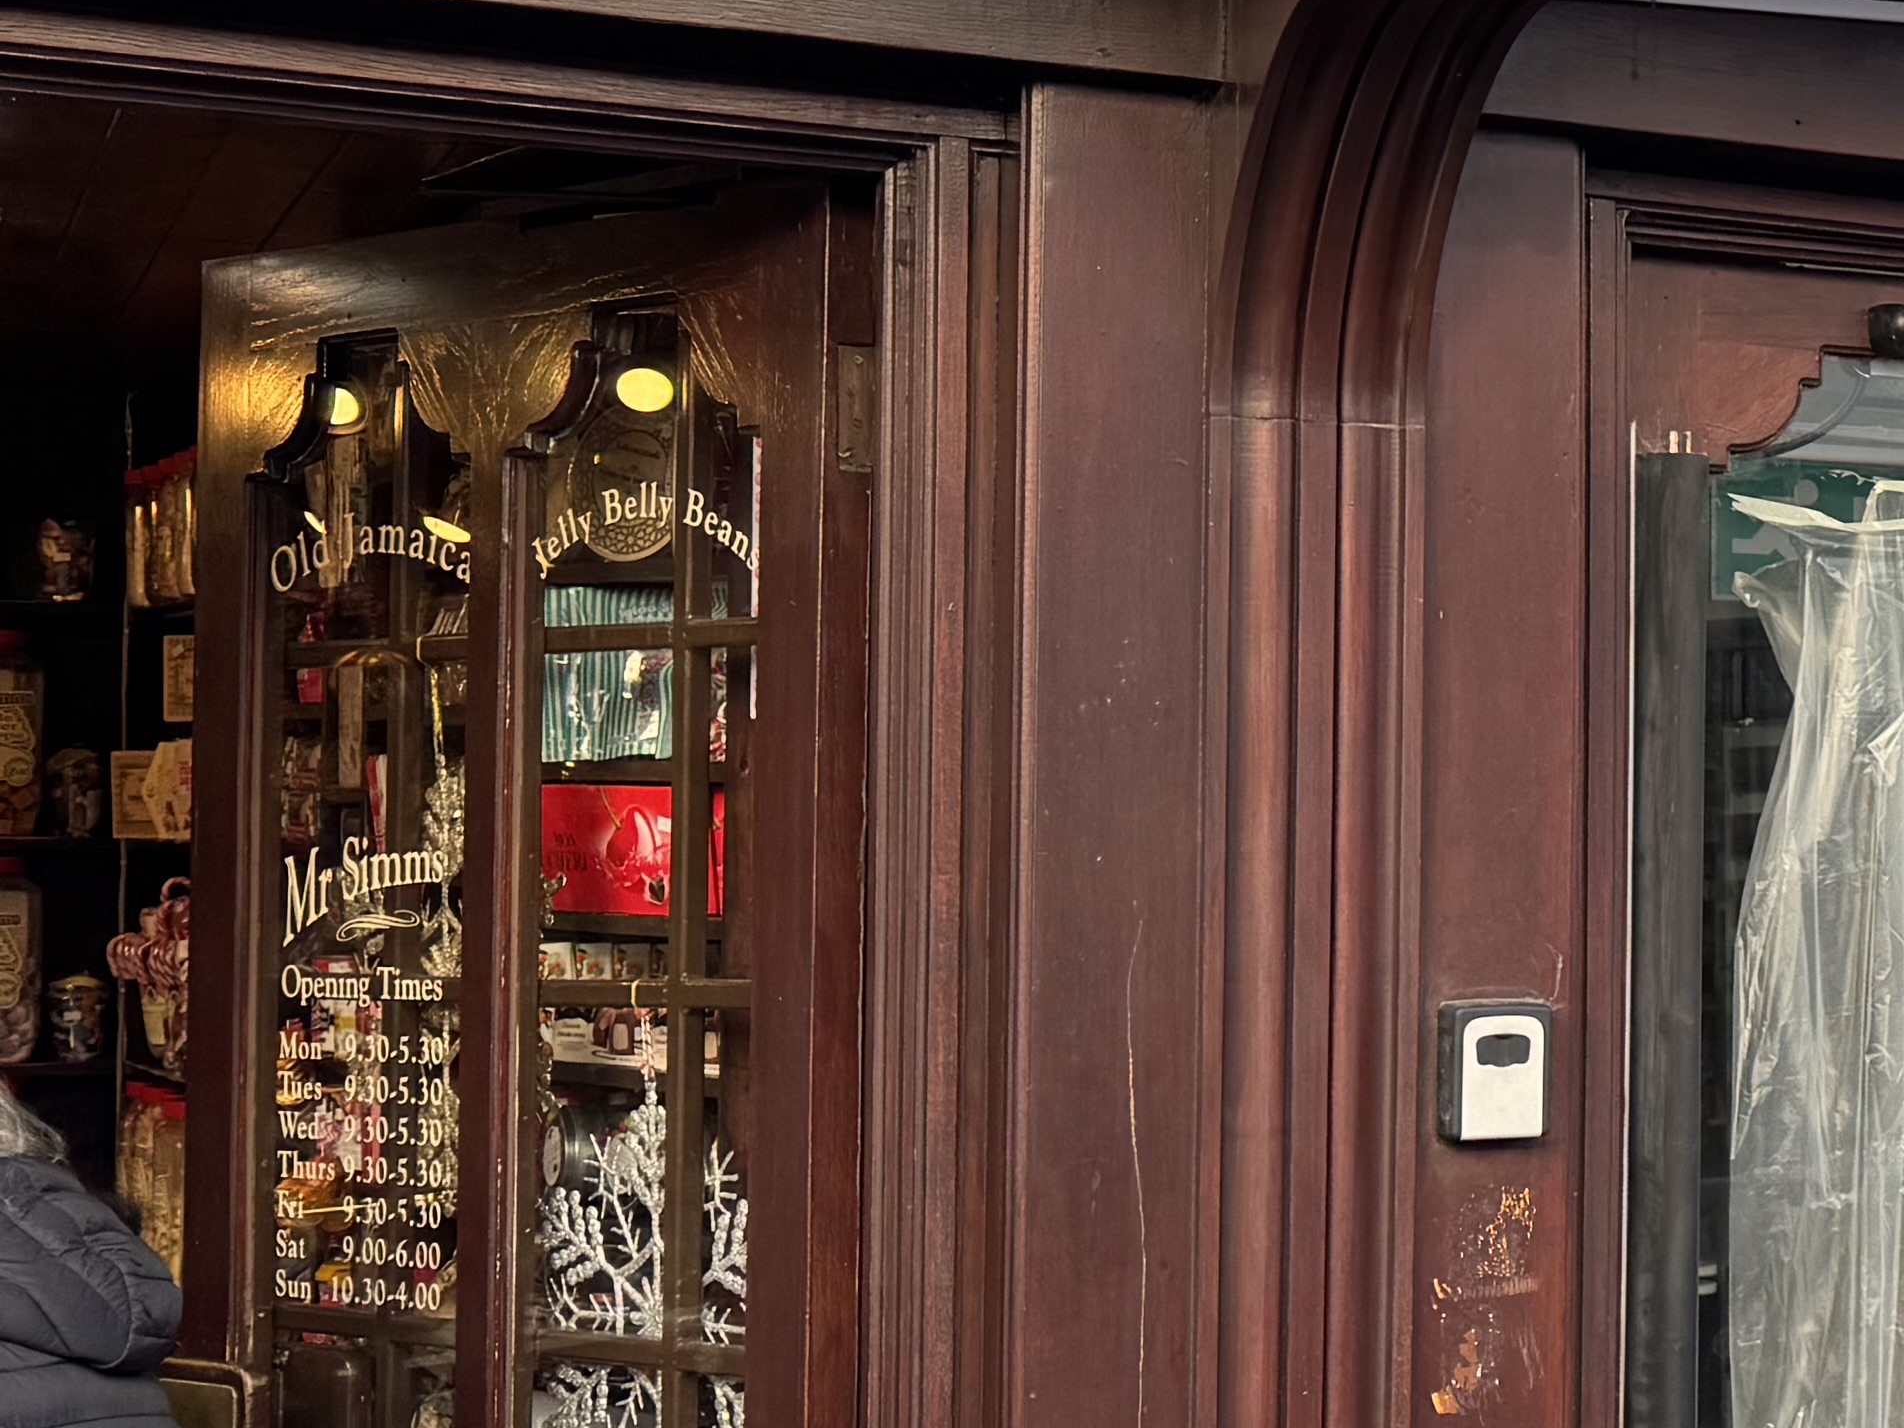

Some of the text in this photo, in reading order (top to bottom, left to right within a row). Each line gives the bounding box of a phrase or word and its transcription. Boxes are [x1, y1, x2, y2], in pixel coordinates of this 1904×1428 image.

[531, 480, 760, 580] Jelly Belly Beans
[270, 511, 471, 593] Old Jamaica
[282, 835, 444, 948] Mr Simms
[281, 963, 444, 1008] Opening Times
[278, 1030, 444, 1066] Mon 9.30-5.30
[276, 1070, 443, 1106] Tues 9.30-5.30
[277, 1110, 443, 1148] Wed 9.30-5.30
[276, 1150, 442, 1188] Thurs 9.30-5.30
[276, 1189, 442, 1230] Fri 9.30-5.30
[275, 1228, 441, 1271] Sat 9.00-6.00
[274, 1268, 441, 1311] Sun 10.30-4.00
